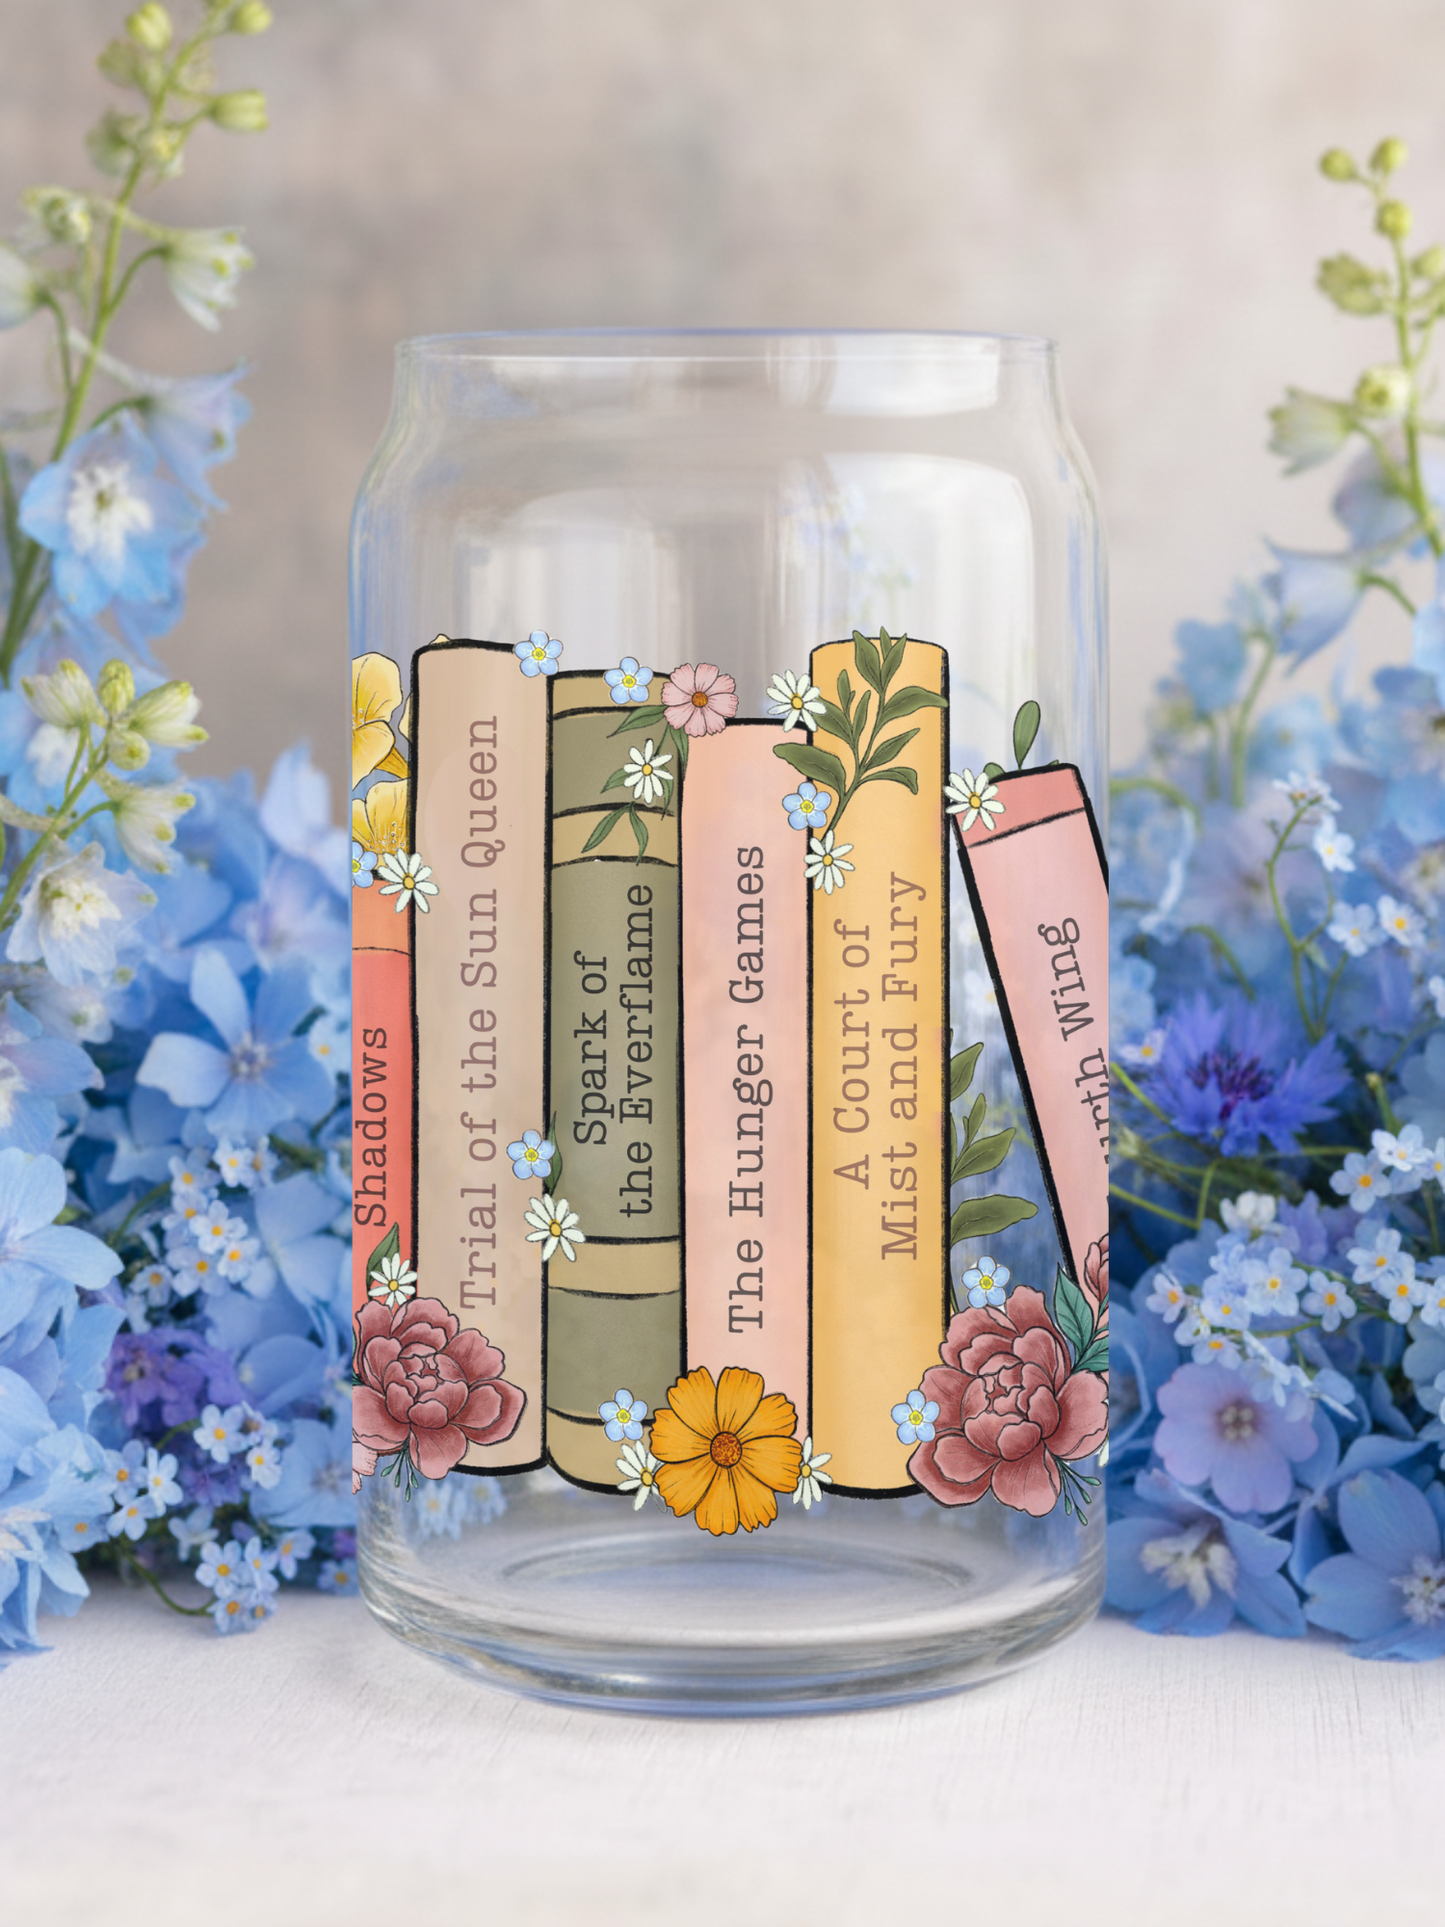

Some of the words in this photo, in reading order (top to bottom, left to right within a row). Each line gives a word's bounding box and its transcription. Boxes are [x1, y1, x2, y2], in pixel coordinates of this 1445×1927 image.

[460, 715, 506, 868] Queen
[459, 888, 498, 988] Sun
[572, 949, 608, 996] of
[728, 845, 765, 1004] Games
[832, 918, 870, 968] of
[881, 871, 927, 1002] Fury
[1036, 917, 1095, 1043] Wing
[460, 1008, 498, 1094] the
[618, 884, 654, 1125] Everflame
[832, 988, 870, 1134] Court
[354, 1027, 388, 1228] Shadows
[572, 1008, 615, 1145] Spark
[728, 1023, 774, 1219] Hunger
[881, 1022, 918, 1121] and
[460, 1111, 498, 1165] of
[618, 1141, 654, 1219] the
[832, 1153, 870, 1191] A
[460, 1183, 498, 1310] Trial
[881, 1141, 918, 1261] Mist
[728, 1237, 765, 1334] The
